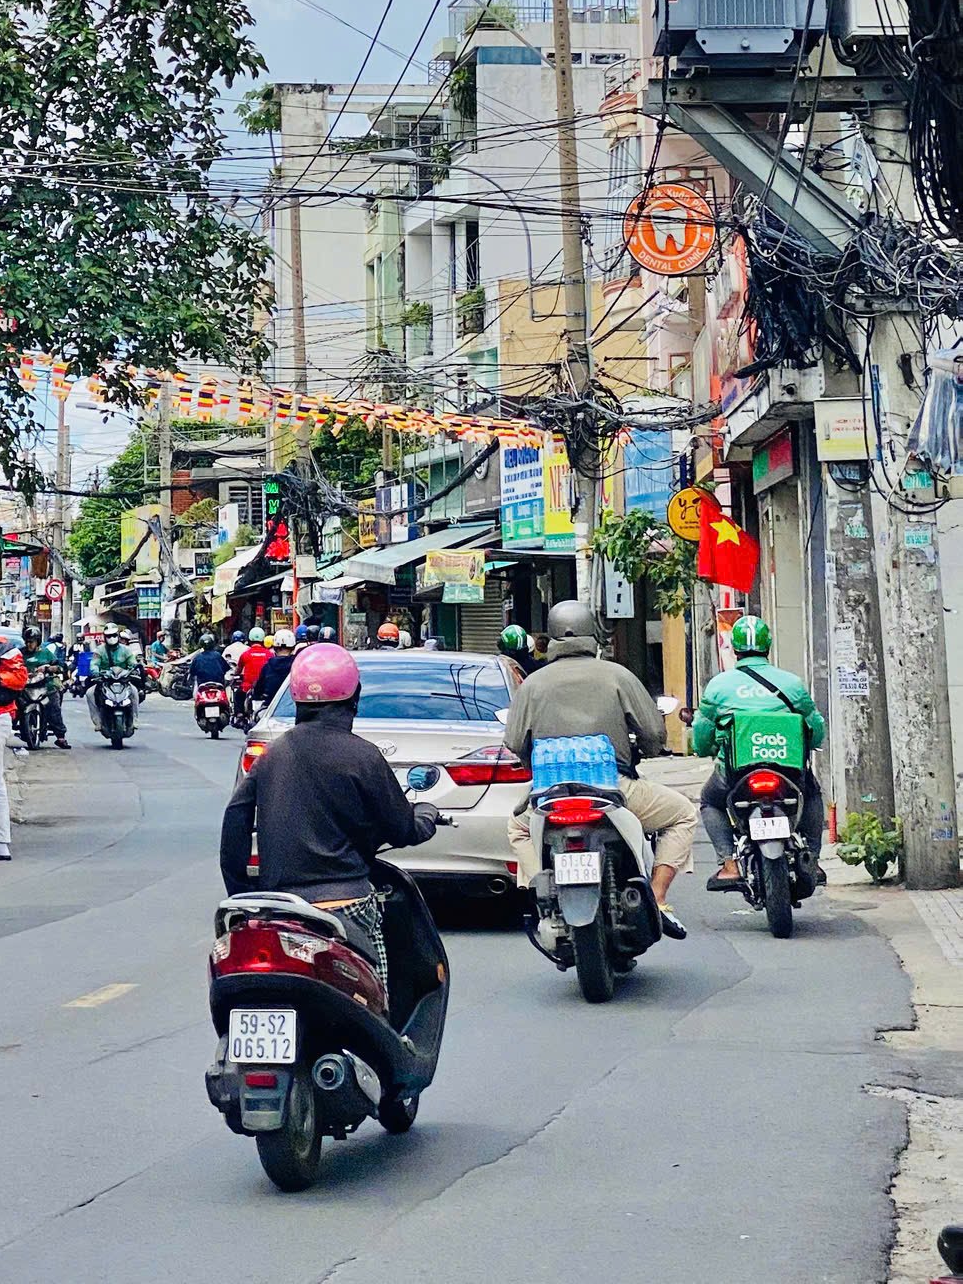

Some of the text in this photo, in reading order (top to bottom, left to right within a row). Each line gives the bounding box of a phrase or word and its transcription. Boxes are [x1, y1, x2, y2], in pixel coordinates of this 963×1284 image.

[638, 247, 706, 272] DENTAL CLINIC
[736, 683, 778, 699] Gra
[751, 732, 787, 746] Grab
[752, 745, 787, 759] Food
[240, 1014, 286, 1036] 59-S2
[233, 1038, 292, 1060] 065.12
